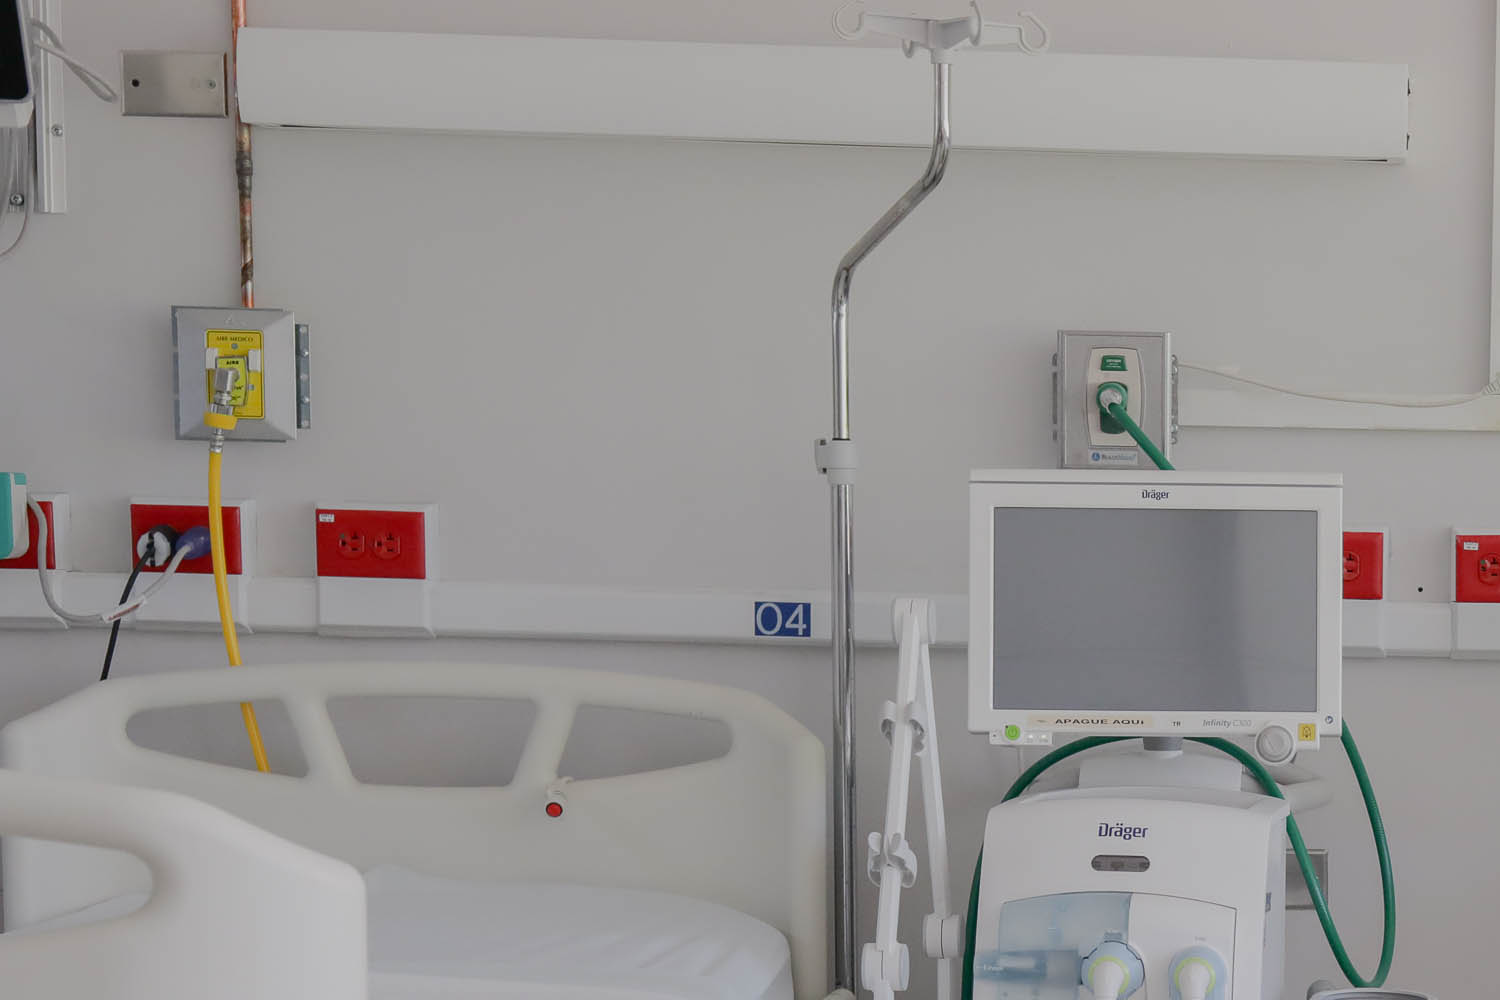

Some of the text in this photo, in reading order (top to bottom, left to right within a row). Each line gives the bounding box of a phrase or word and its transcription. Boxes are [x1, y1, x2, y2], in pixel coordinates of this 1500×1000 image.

[1141, 489, 1170, 501] Dräger
[756, 602, 807, 636] 04
[1203, 719, 1231, 728] Infinity
[1098, 822, 1149, 840] Dräger
